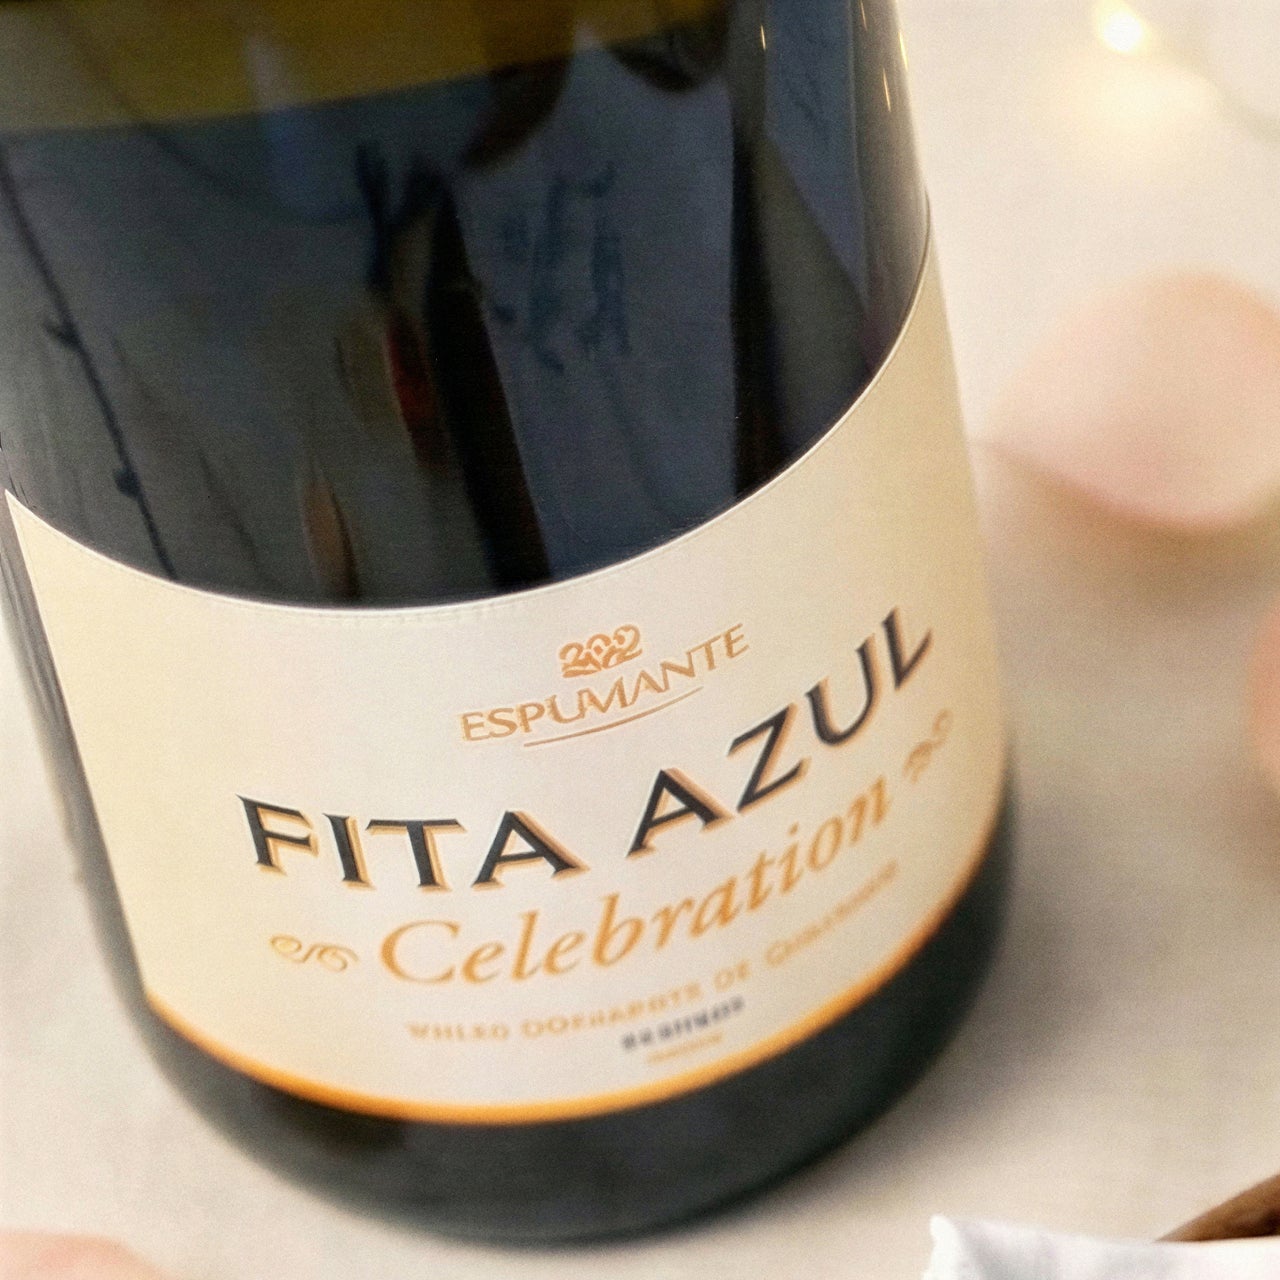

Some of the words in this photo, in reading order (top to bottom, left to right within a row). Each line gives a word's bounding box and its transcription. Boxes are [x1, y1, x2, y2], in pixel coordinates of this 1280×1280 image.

[236, 794, 591, 893] FITA
[626, 605, 934, 862] AZUL
[460, 623, 750, 742] ESPUMANTE
[379, 774, 890, 986] Celebration
